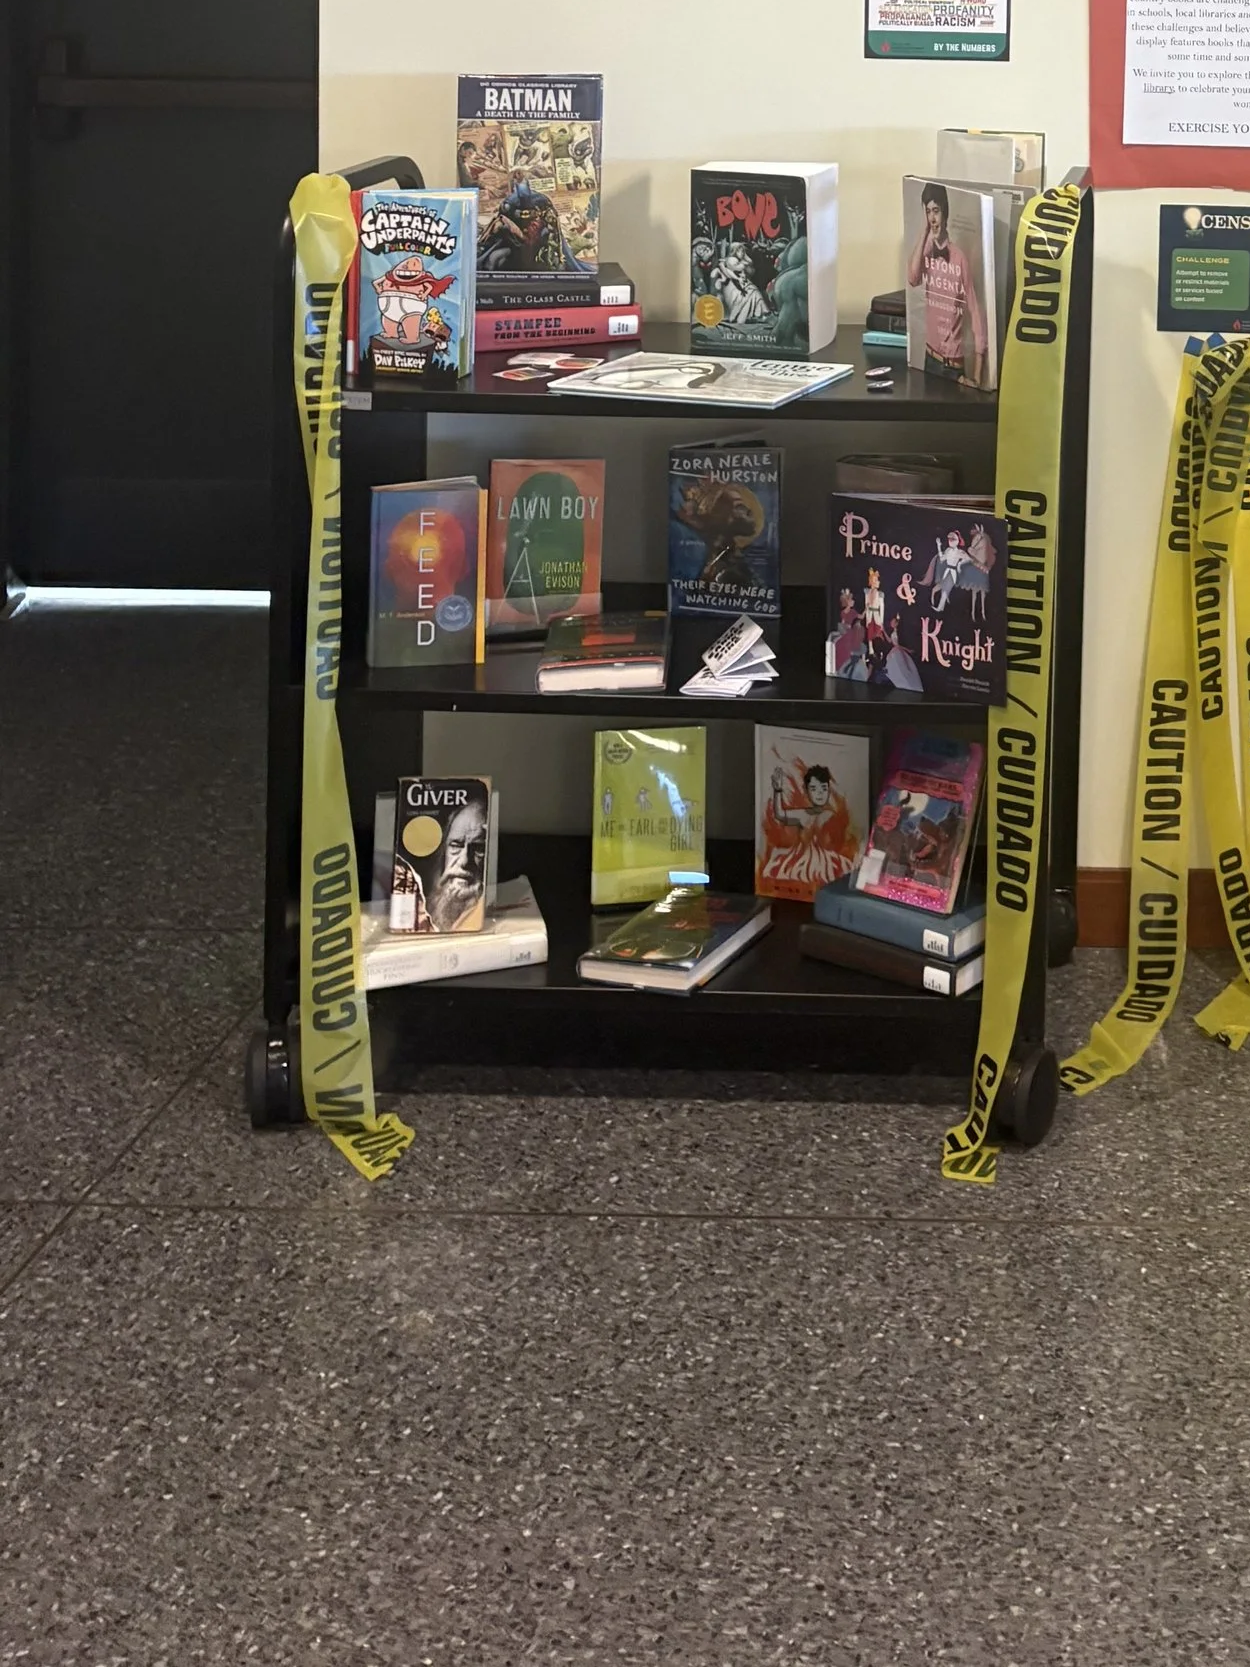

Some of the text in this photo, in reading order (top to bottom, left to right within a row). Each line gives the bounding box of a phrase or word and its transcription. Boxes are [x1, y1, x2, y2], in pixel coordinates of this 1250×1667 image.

[935, 17, 975, 26] RACISM
[934, 43, 943, 51] BY
[962, 43, 995, 52] NUMBERS
[484, 88, 572, 112] BATMAN
[485, 110, 513, 118] DEATH
[1168, 123, 1229, 134] EXERCISE
[716, 190, 783, 240] BONE
[361, 228, 455, 254] UNDERPANTS
[924, 256, 962, 278] BEYOND
[922, 273, 966, 296] MAGENTA
[721, 333, 777, 344] JEFF SMITH
[671, 454, 772, 471] ZORA NEALE
[710, 469, 778, 483] HURSTON
[497, 496, 599, 520] LAWN BOY
[839, 512, 913, 562] Prince
[672, 579, 774, 600] THEIR EYES WERE
[897, 573, 917, 605] &
[686, 594, 777, 614] WATCHING GOD
[921, 616, 995, 671] Knight
[997, 490, 1047, 913] CAUTION / CUIDADO
[407, 783, 468, 807] GIVER
[1115, 679, 1189, 1024] CAUTION / CUIDADO
[312, 842, 359, 1032] CUIDADO
